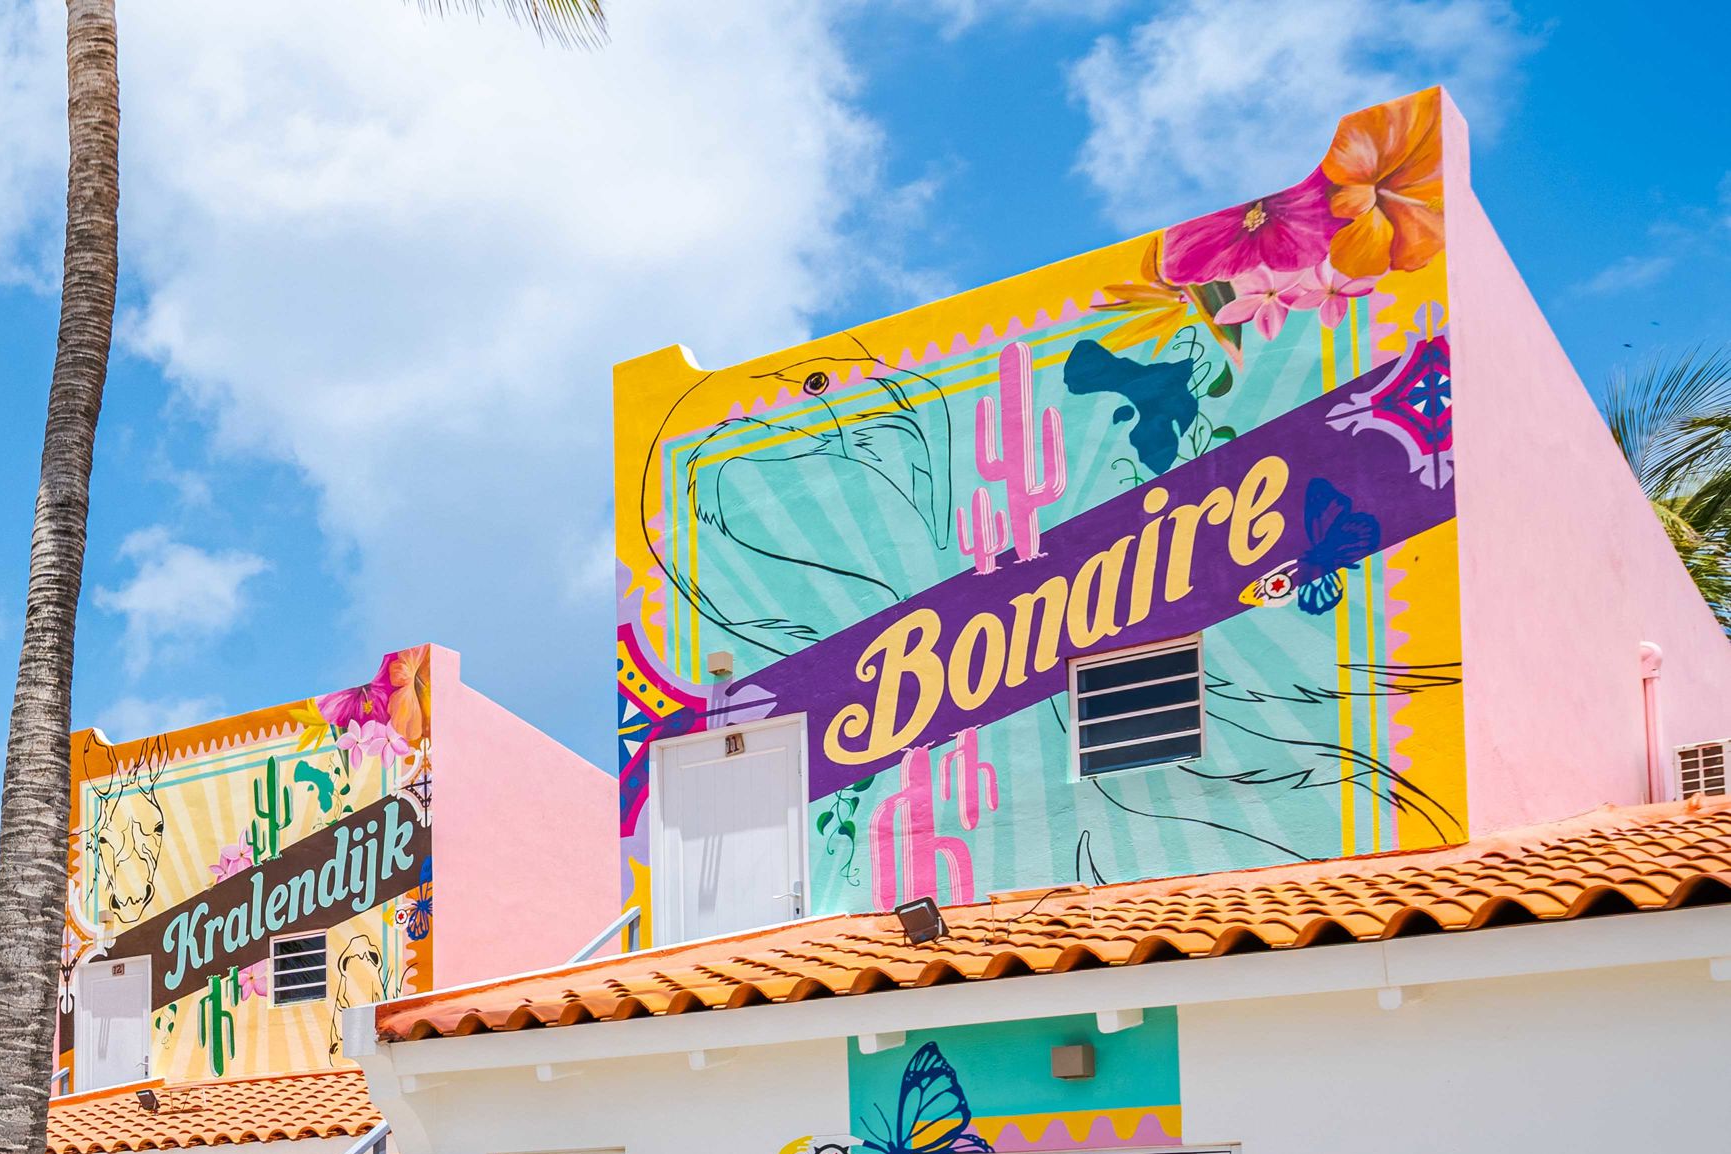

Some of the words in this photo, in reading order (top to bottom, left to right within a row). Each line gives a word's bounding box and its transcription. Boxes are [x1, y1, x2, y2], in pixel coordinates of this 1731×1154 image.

[824, 455, 1289, 765] Bonaire
[725, 735, 740, 755] 11
[162, 801, 414, 990] Kralendijk
